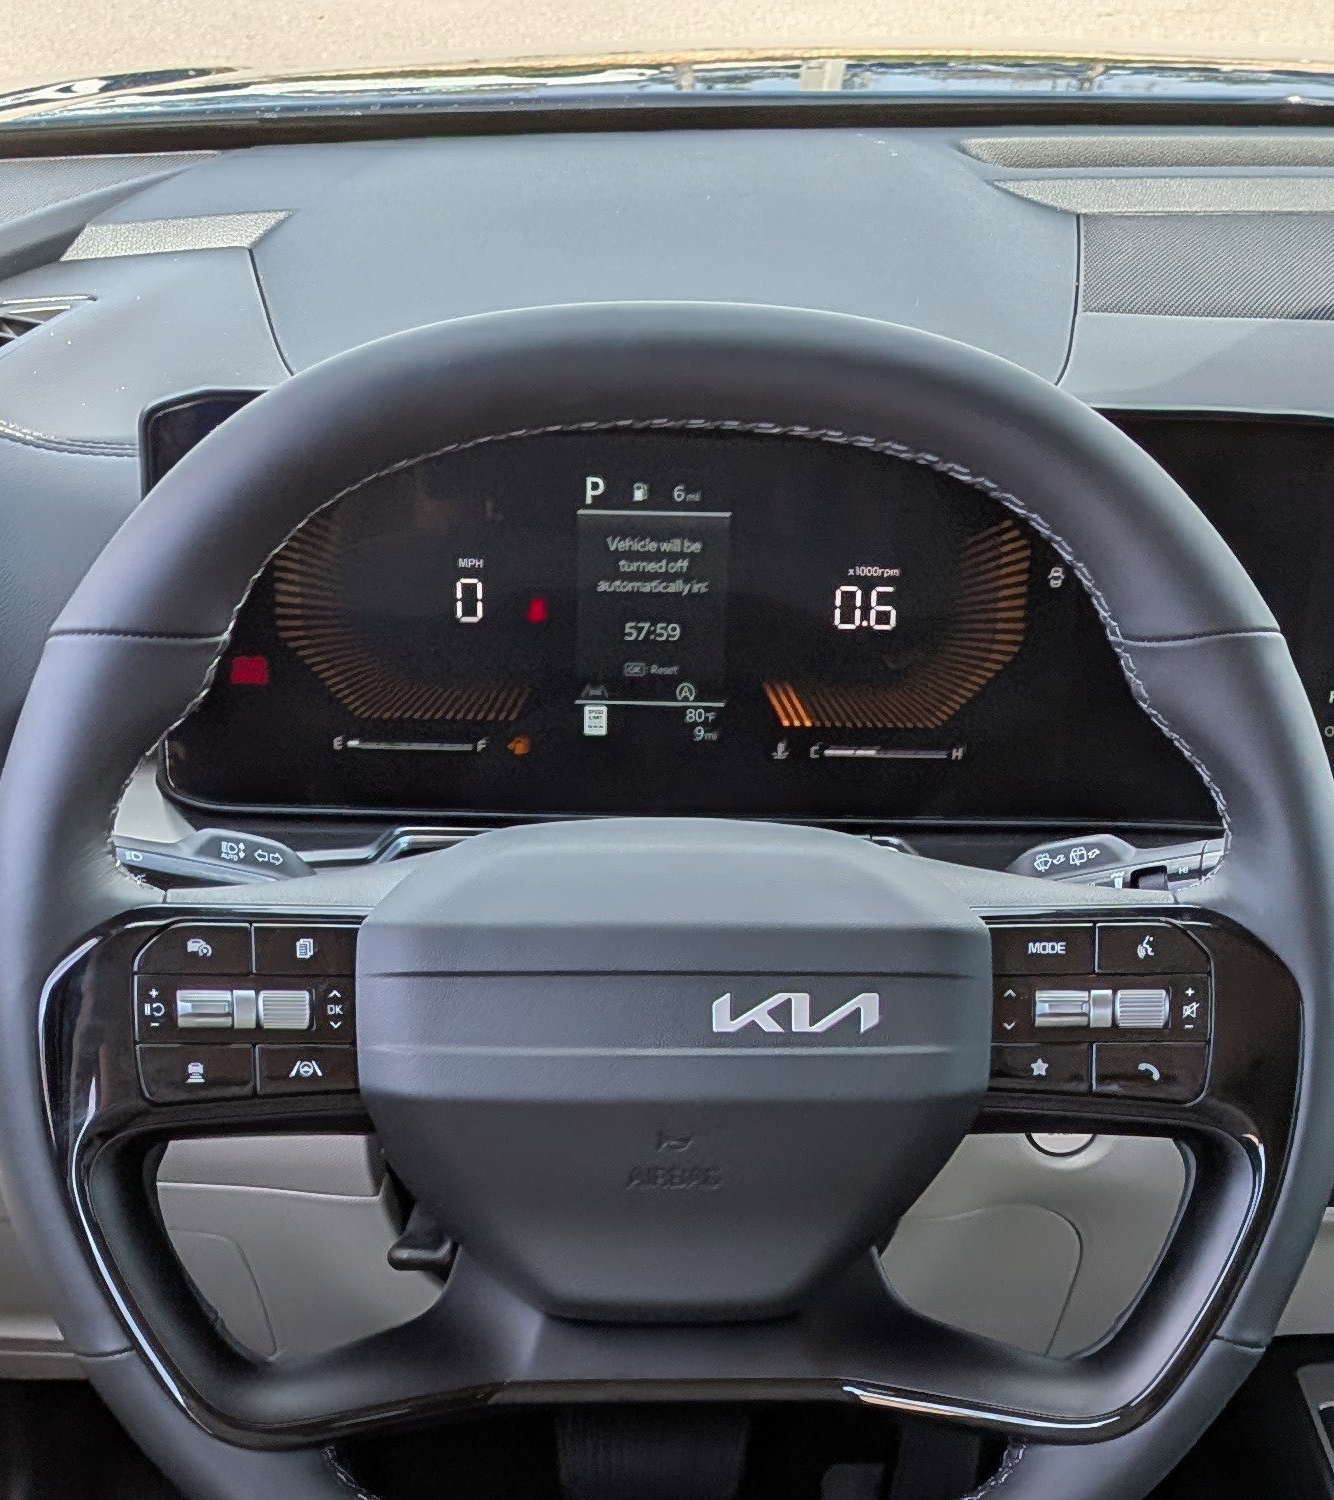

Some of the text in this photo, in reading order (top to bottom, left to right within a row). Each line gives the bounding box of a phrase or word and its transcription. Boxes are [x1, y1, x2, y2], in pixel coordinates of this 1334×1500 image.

[585, 476, 605, 504] P
[606, 536, 703, 553] Vehicle will be
[458, 557, 484, 569] MPH
[618, 558, 690, 574] turned off
[848, 566, 900, 578] x1000rpm
[596, 579, 690, 597] automatically
[455, 577, 484, 623] 0
[833, 585, 898, 631] 0.6
[624, 622, 681, 641] 57:59
[220, 852, 239, 862] AUTO
[1028, 942, 1067, 954] MODE
[327, 1004, 343, 1016] OK
[712, 992, 880, 1033] KIA
